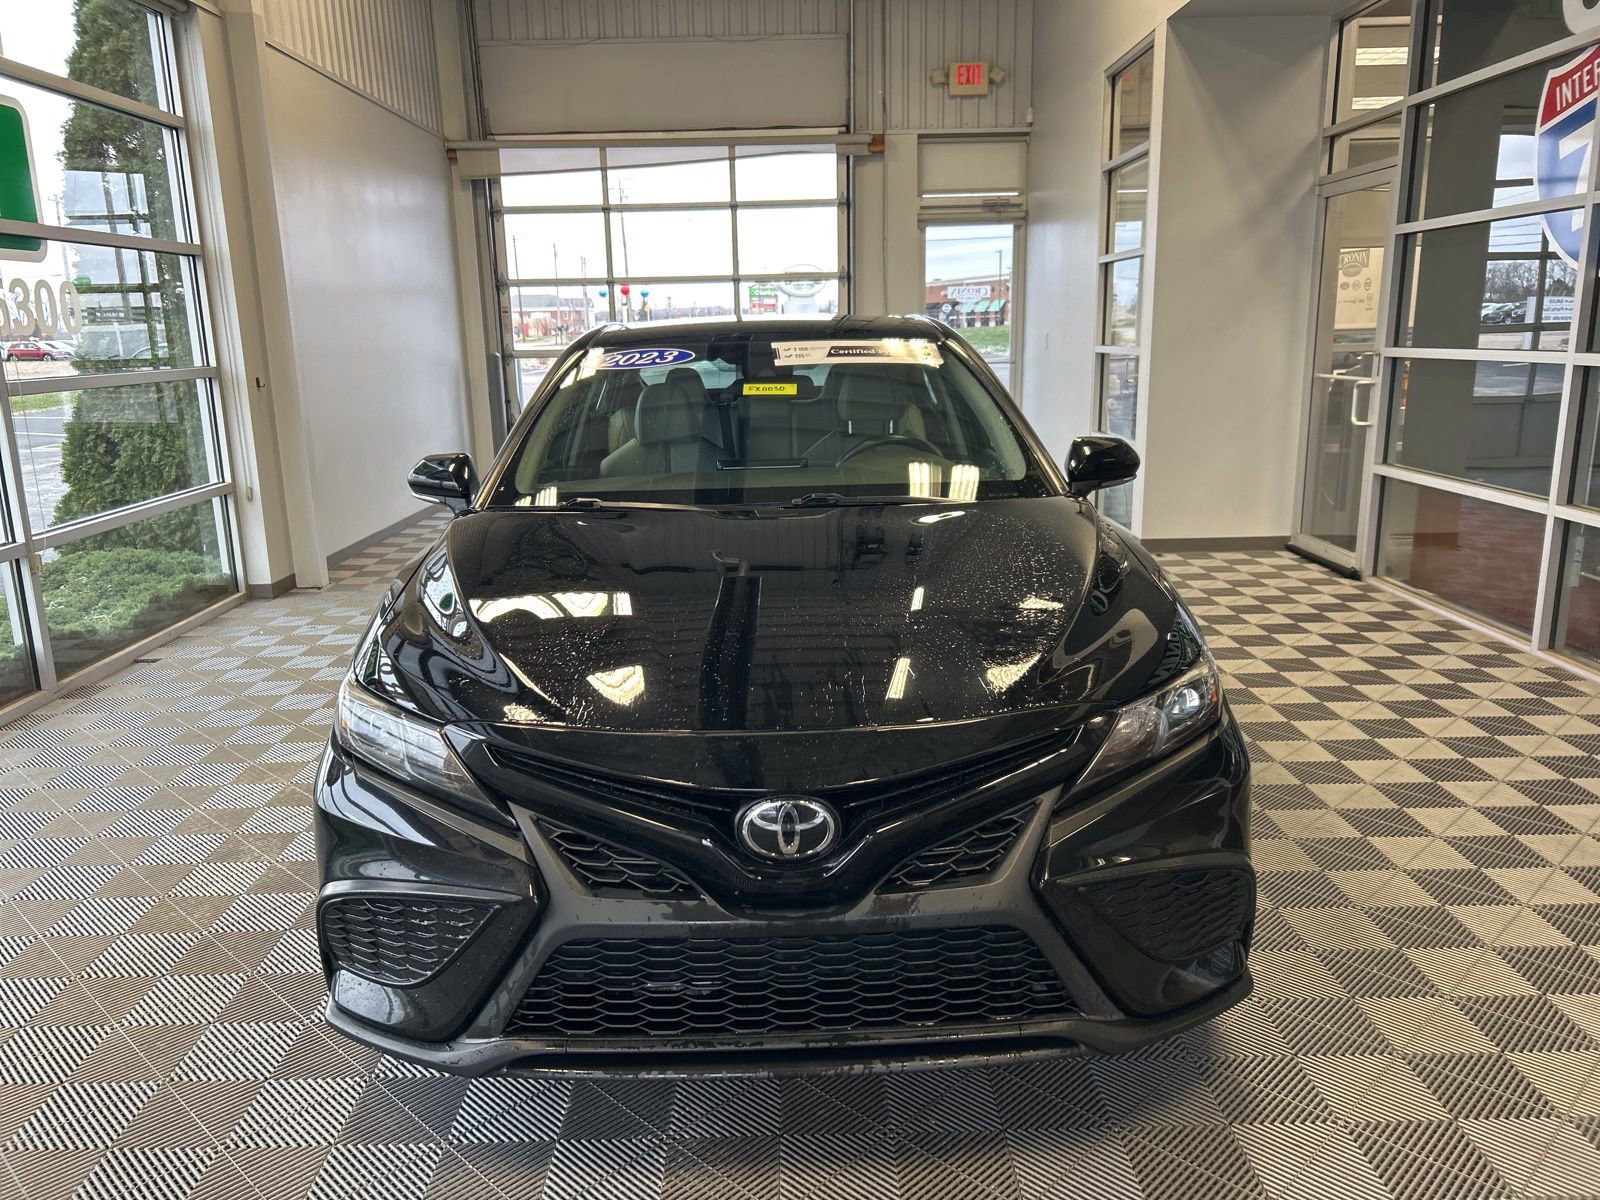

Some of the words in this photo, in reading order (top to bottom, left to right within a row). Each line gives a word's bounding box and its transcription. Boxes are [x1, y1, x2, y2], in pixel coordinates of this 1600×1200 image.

[957, 64, 982, 85] EXIT
[600, 350, 679, 367] 2023
[830, 348, 876, 356] Certified
